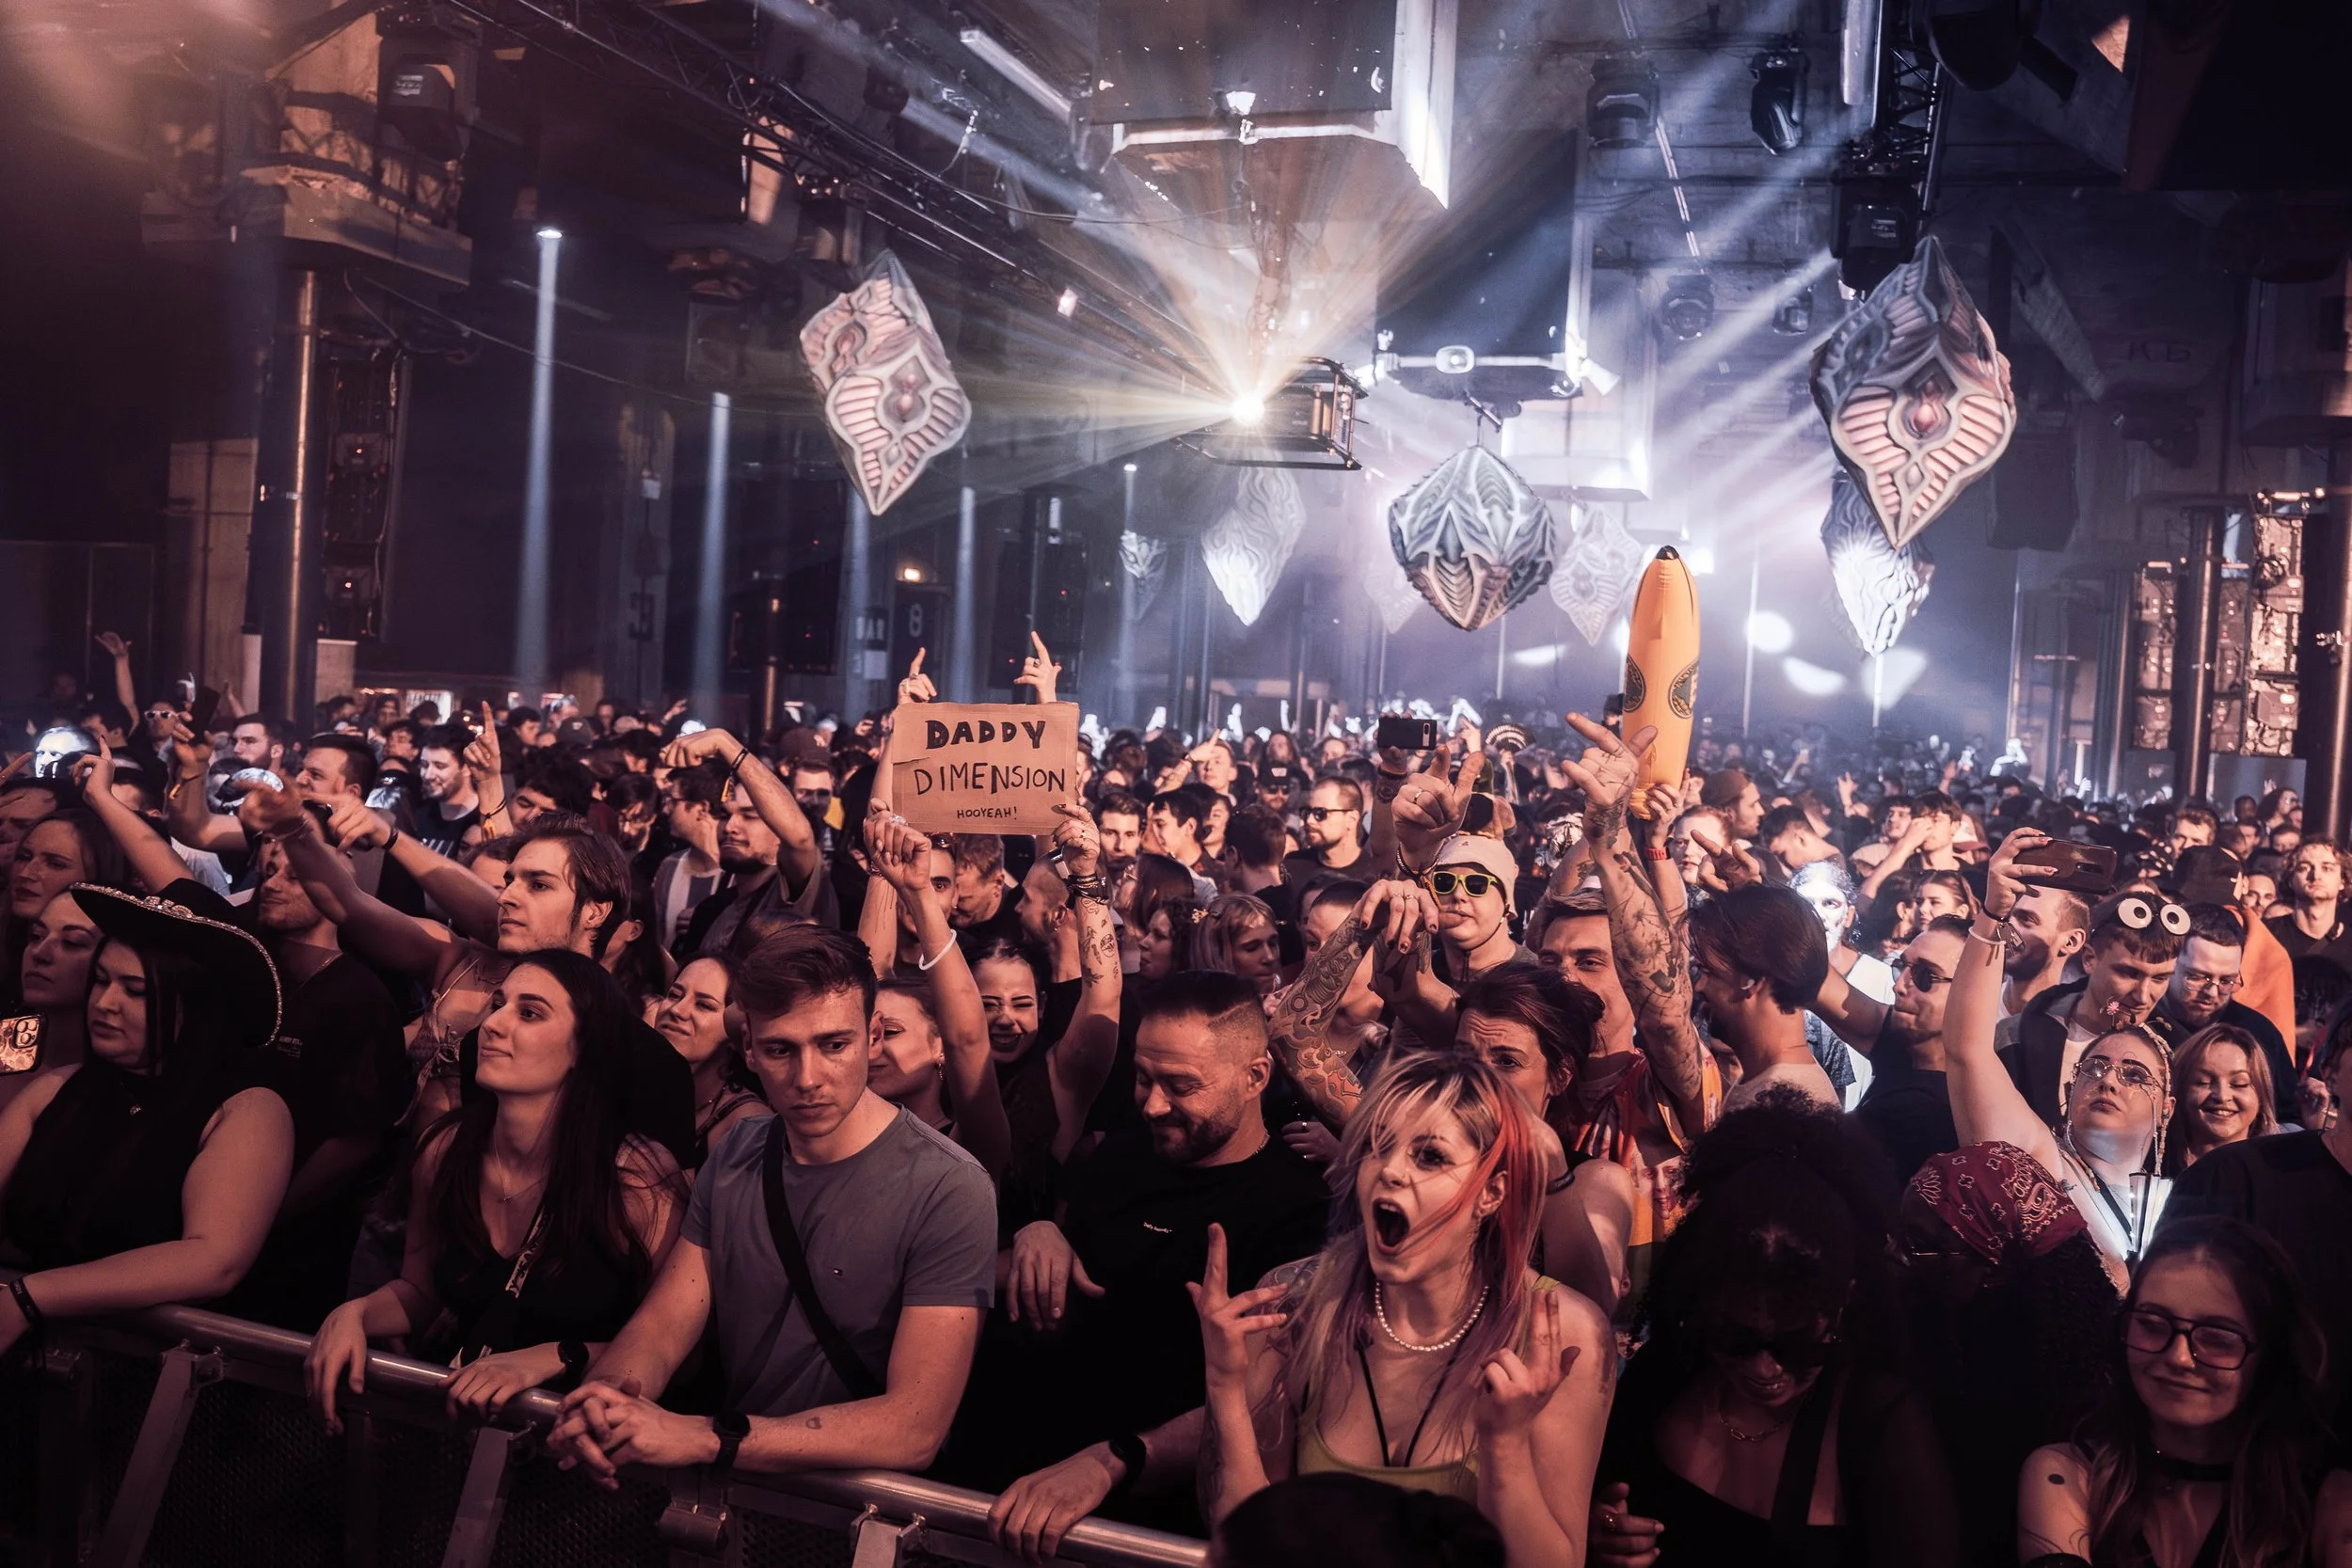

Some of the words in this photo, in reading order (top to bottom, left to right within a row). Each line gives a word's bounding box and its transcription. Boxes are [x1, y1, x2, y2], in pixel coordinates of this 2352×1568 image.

[926, 720, 1046, 750] DADDY
[914, 762, 1065, 795] DIMENSION
[957, 806, 1017, 819] HOOYEAH!
